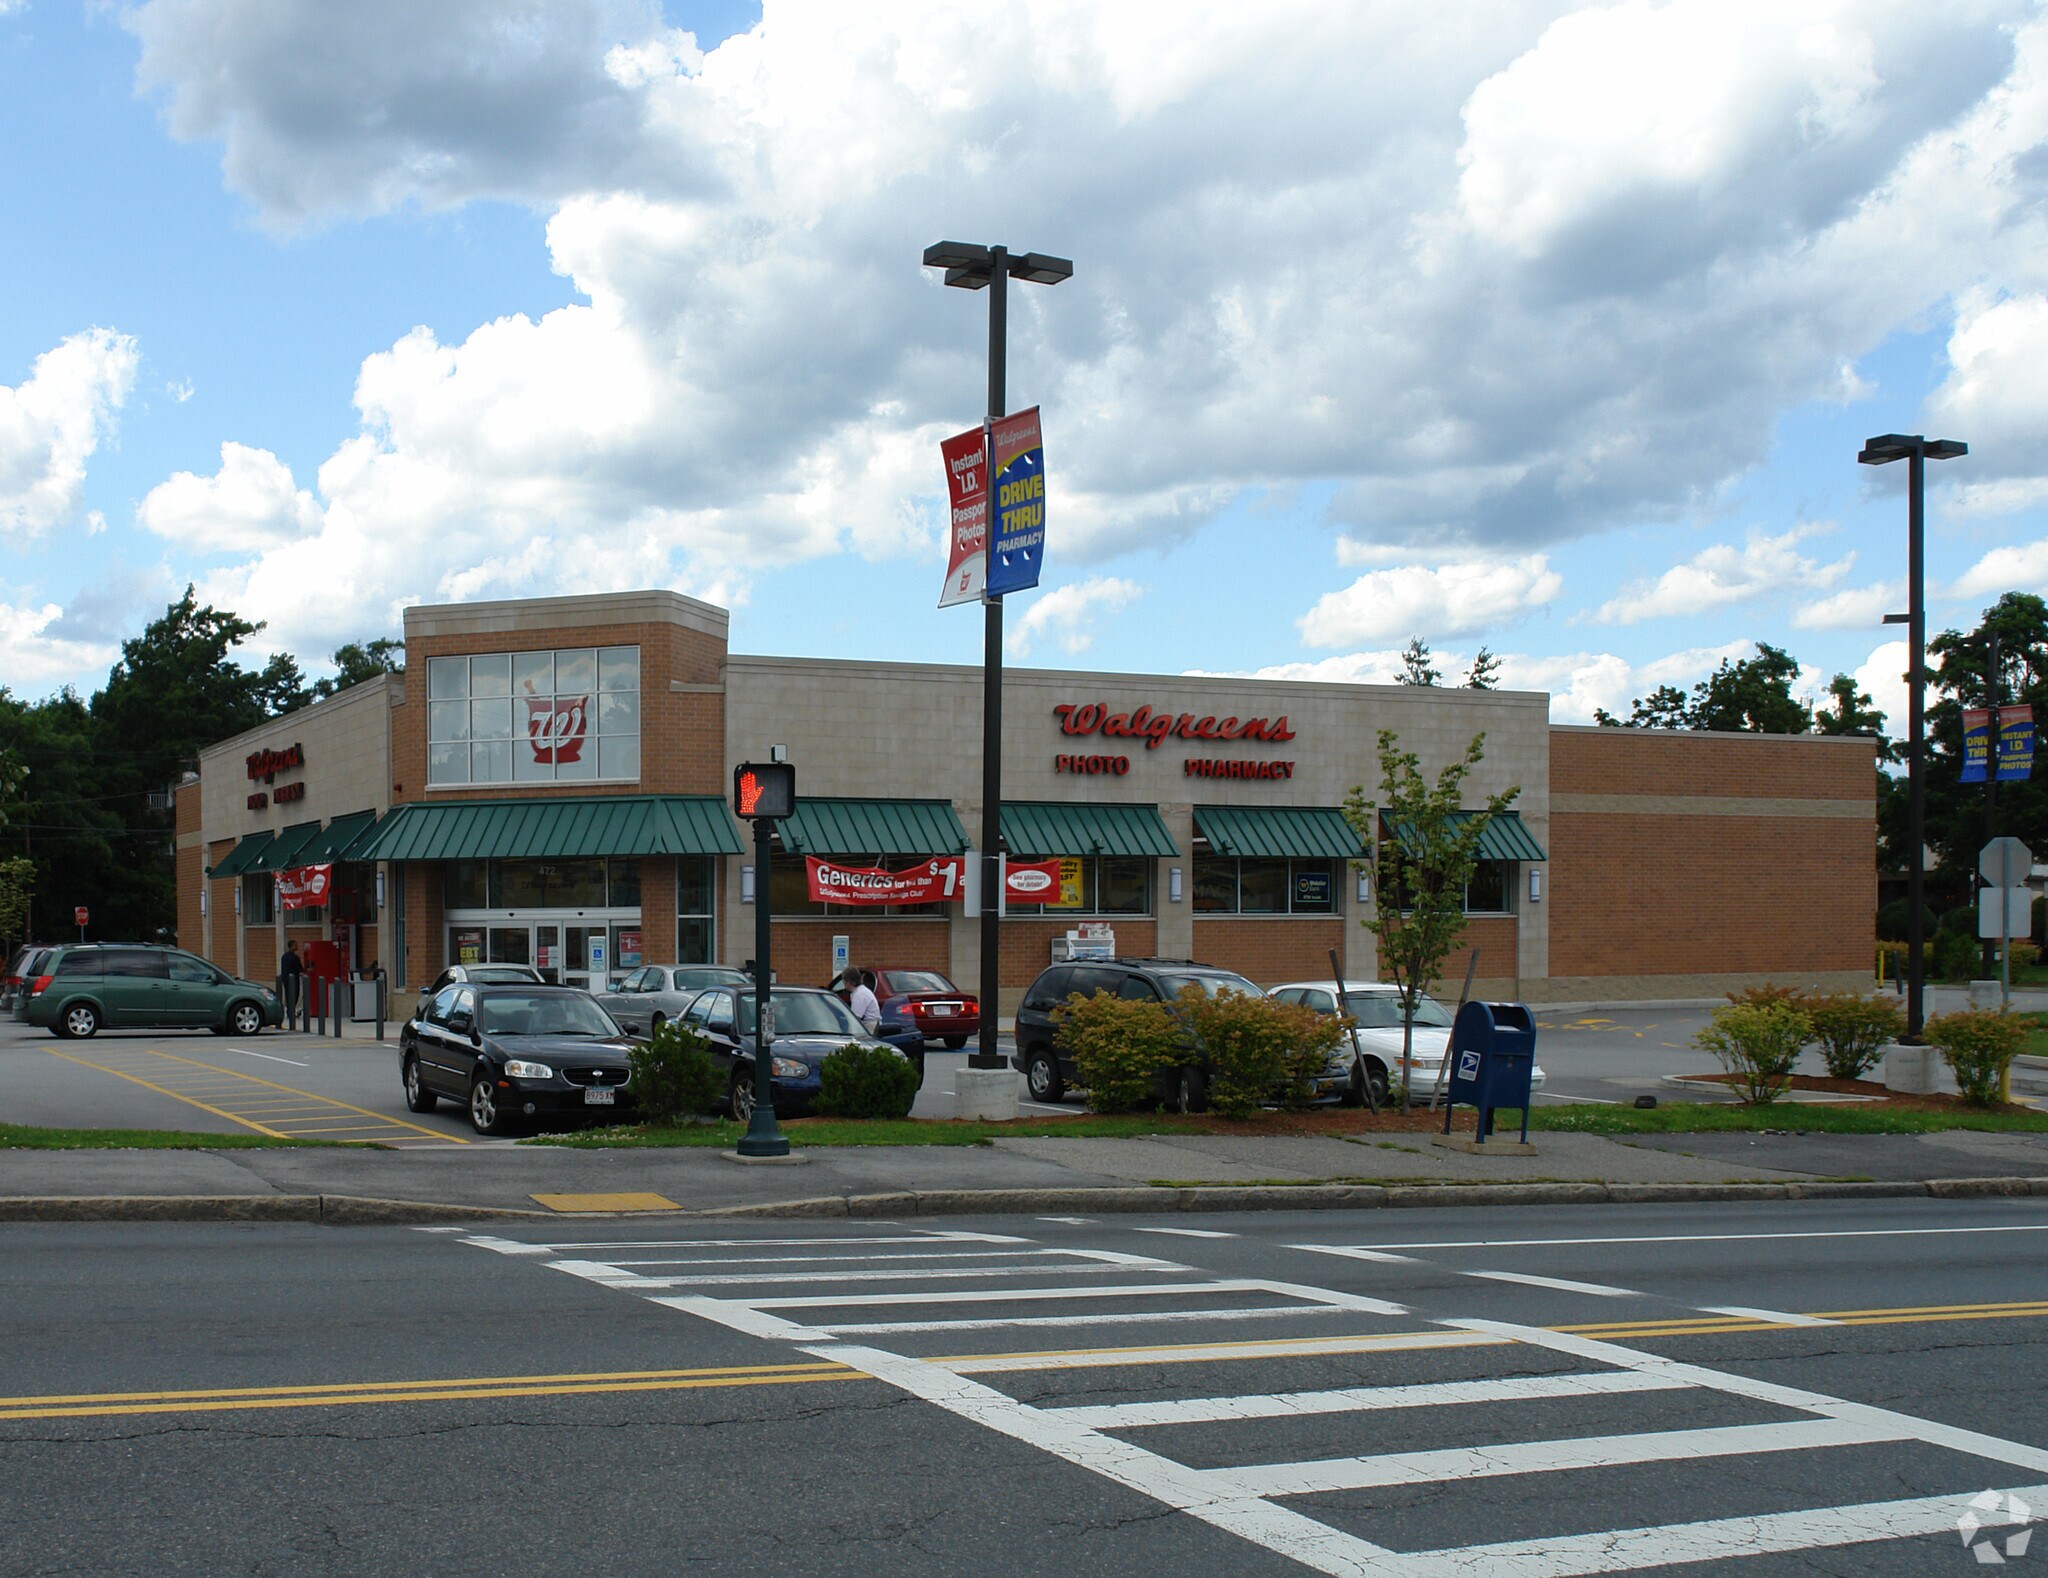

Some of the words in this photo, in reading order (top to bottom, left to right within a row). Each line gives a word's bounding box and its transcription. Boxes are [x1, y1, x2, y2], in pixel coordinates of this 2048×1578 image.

[951, 448, 984, 474] Instant
[961, 473, 979, 494] I.D.
[1000, 475, 1043, 507] DRIVE
[953, 502, 987, 524] Passpor
[1002, 503, 1042, 533] THRU
[957, 522, 985, 543] Photos
[997, 530, 1043, 553] PHARMACY
[1053, 702, 1296, 750] Walgreens
[1968, 747, 1988, 758] THR
[1055, 754, 1130, 775] PHOTO
[1184, 758, 1295, 779] PHARMACY
[539, 866, 555, 875] 472
[817, 865, 894, 888] Generics
[460, 946, 480, 958] EBT
